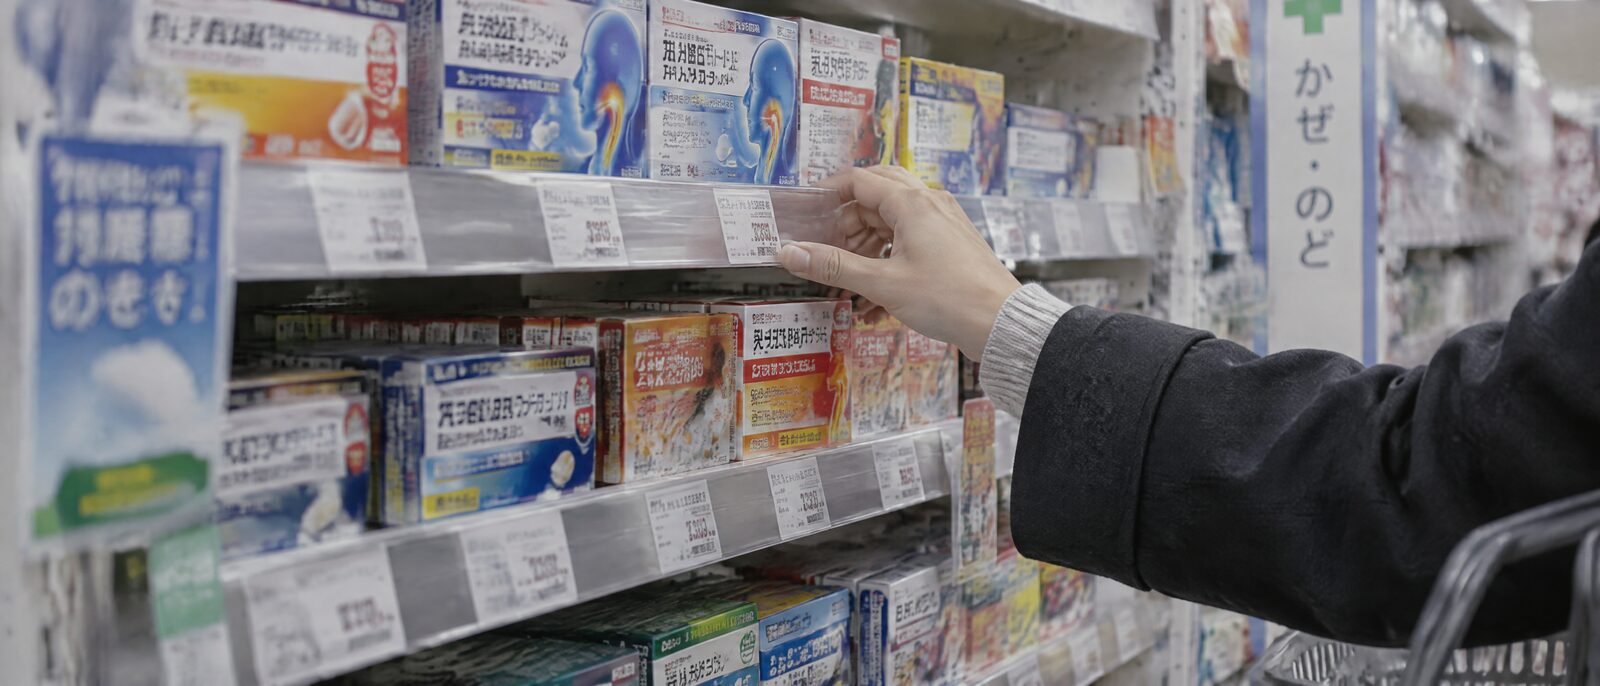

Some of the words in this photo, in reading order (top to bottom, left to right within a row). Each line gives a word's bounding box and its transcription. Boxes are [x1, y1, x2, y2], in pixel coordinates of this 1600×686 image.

[1295, 58, 1334, 269] かぜ・のど
